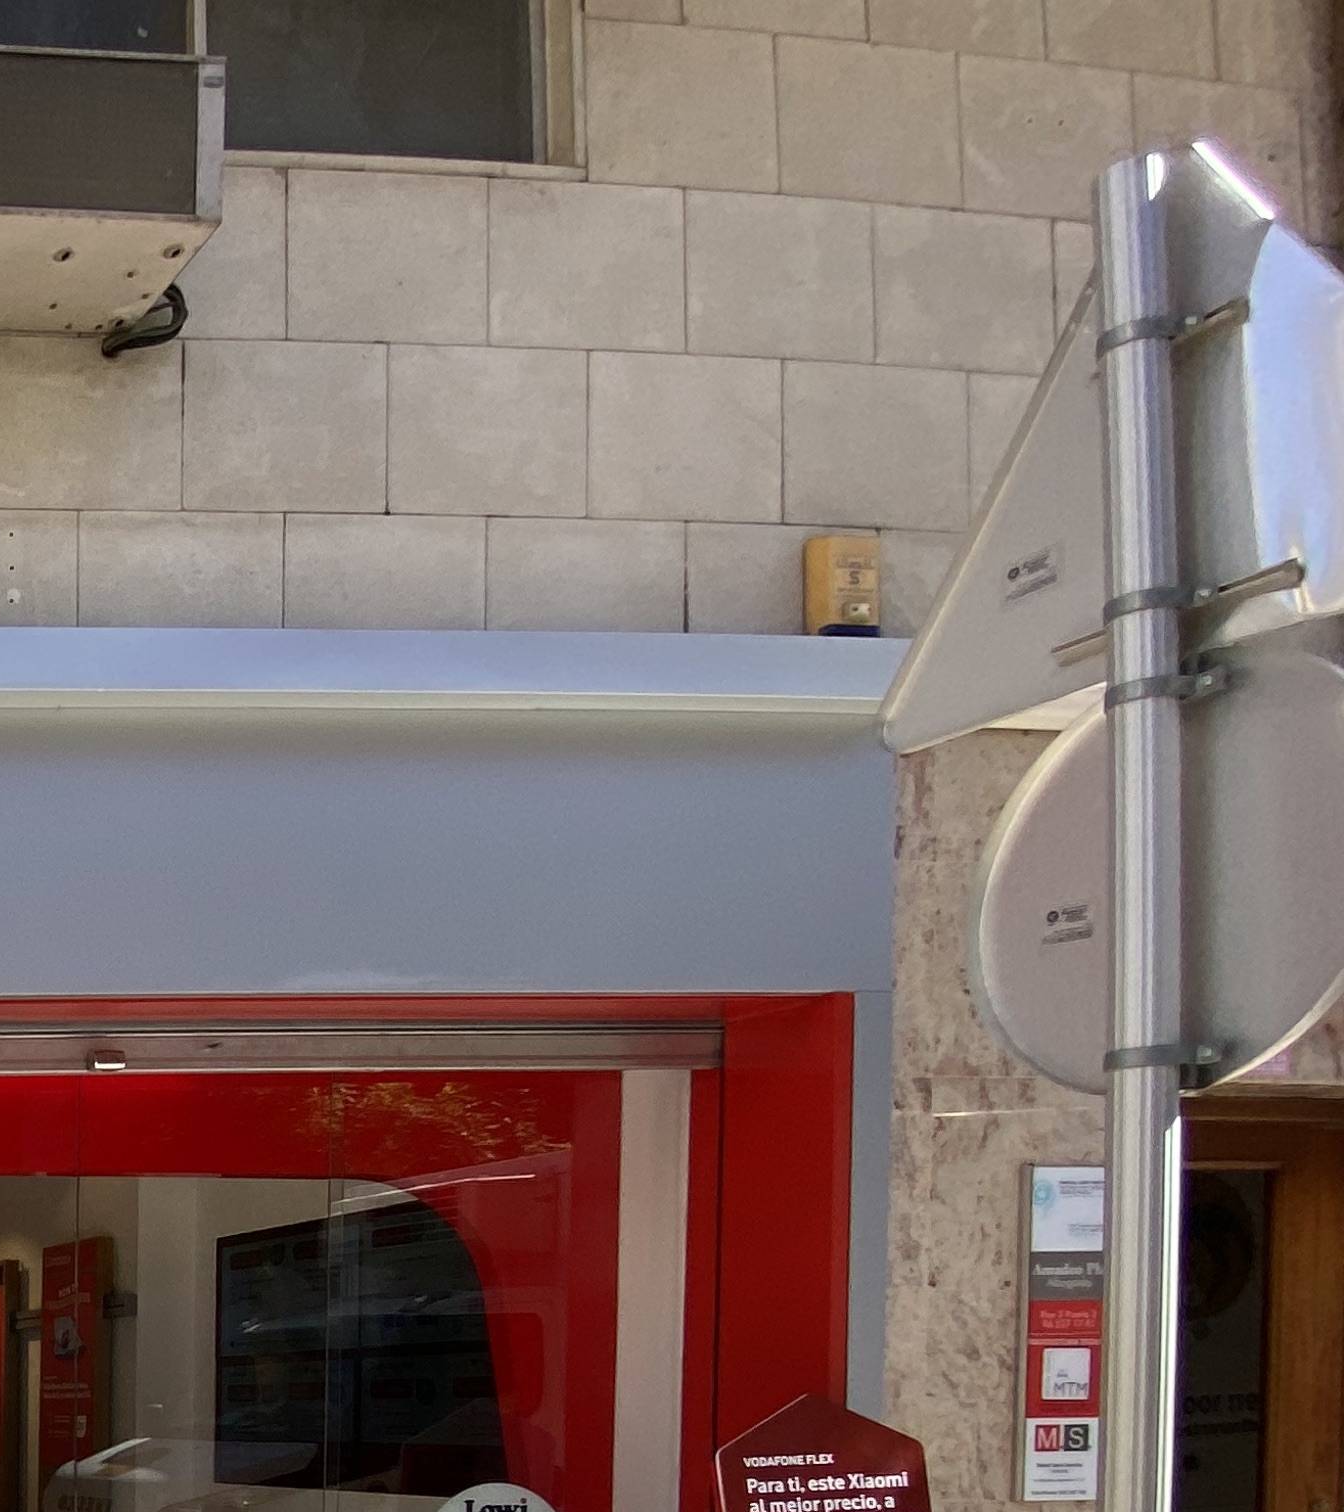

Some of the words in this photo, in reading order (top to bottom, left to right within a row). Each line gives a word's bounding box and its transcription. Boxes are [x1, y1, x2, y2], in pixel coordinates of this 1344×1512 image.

[743, 1455, 805, 1468] VODAFONE
[806, 1453, 834, 1466] FLEX
[746, 1478, 784, 1494] Para
[808, 1475, 845, 1492] este
[847, 1471, 909, 1490] Xiaomi
[884, 1496, 895, 1509] a
